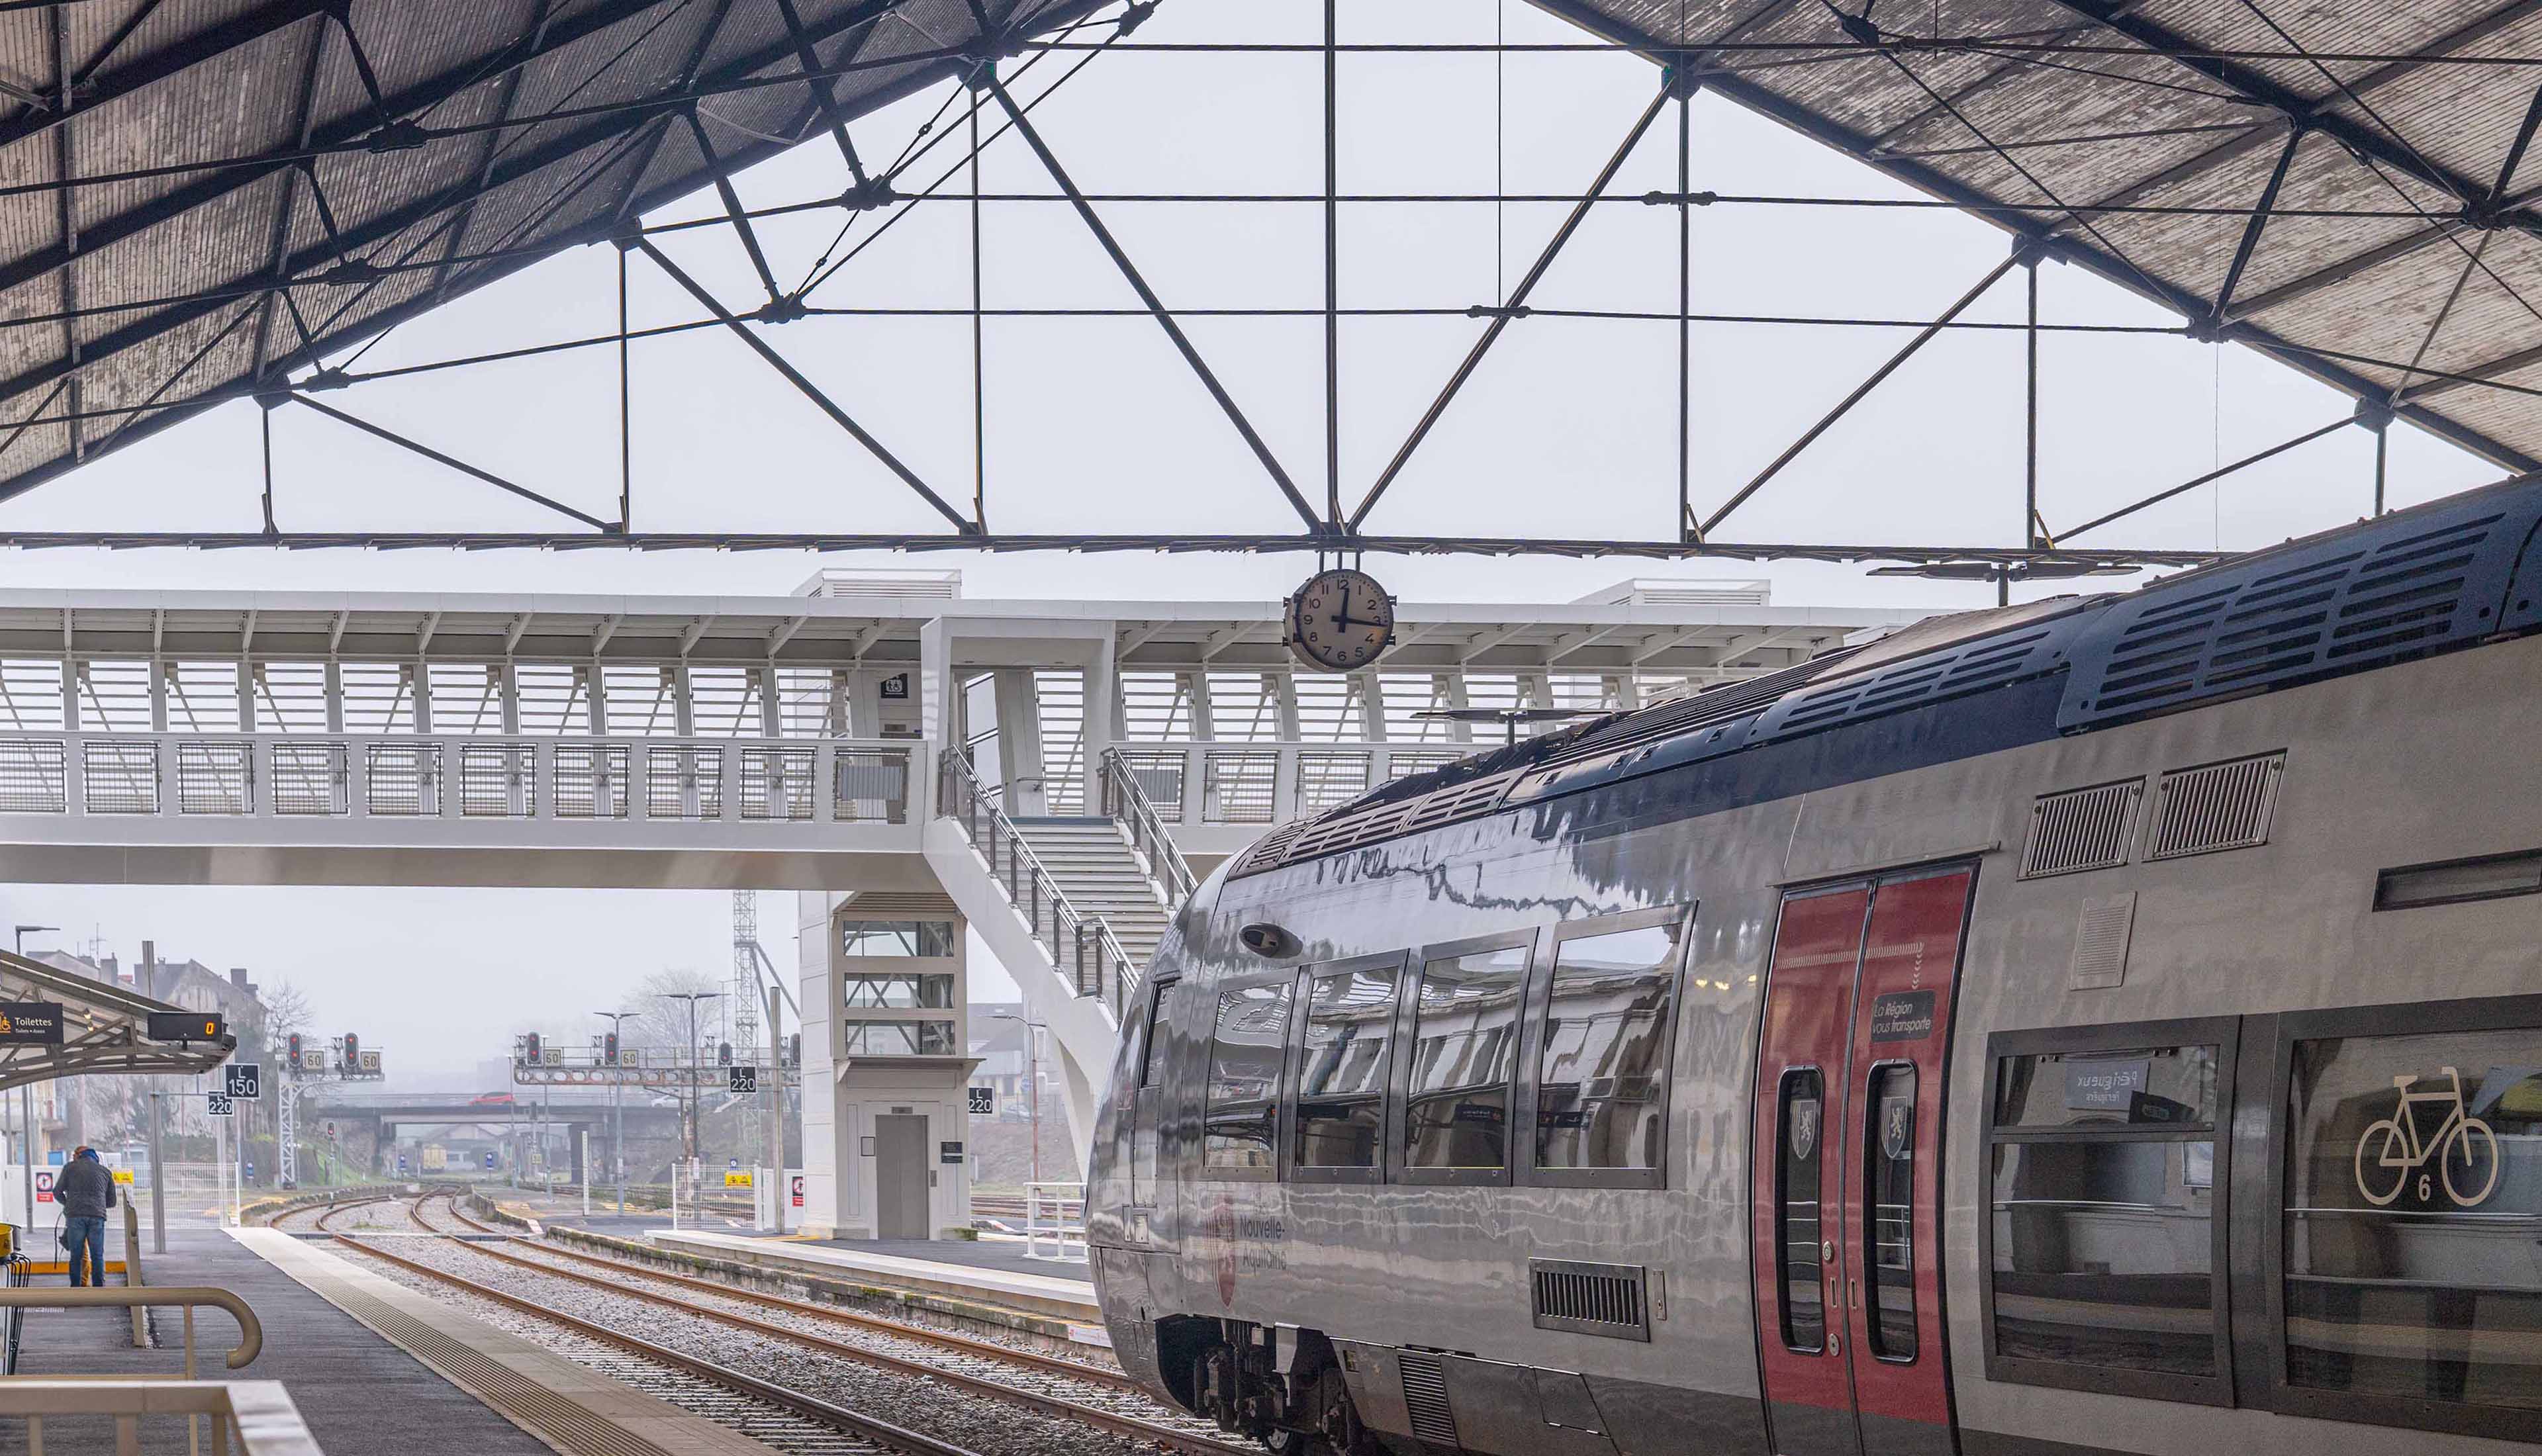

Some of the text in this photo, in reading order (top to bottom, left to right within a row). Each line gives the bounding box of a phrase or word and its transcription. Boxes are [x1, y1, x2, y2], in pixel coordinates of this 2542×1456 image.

[1322, 584, 1329, 594] 11
[1337, 580, 1348, 590] 12
[1309, 598, 1320, 608] 10
[1368, 600, 1376, 610] 2
[1304, 615, 1313, 624] 9
[1373, 615, 1380, 625] 3
[1309, 633, 1317, 641] 8
[1365, 633, 1373, 643] 4
[1323, 647, 1331, 657] 7
[1338, 652, 1346, 660] 6
[1355, 647, 1363, 657] 5
[1874, 1001, 1912, 1018] La Région
[15, 1017, 52, 1026] Toilettes
[1873, 1017, 1931, 1033] vous transporte
[307, 1055, 321, 1066] 60
[364, 1056, 377, 1067] 60
[546, 1053, 558, 1064] 60
[623, 1054, 636, 1064] 60
[238, 1066, 246, 1078] L
[739, 1069, 745, 1078] L
[229, 1079, 256, 1095] 150
[731, 1079, 755, 1091] 220
[976, 1089, 982, 1099] L
[209, 1102, 232, 1113] 220
[968, 1099, 992, 1112] 220
[2418, 1174, 2431, 1201] 6
[1240, 1215, 1285, 1239] Nouvelle-
[1243, 1245, 1286, 1275] Aquitaine
